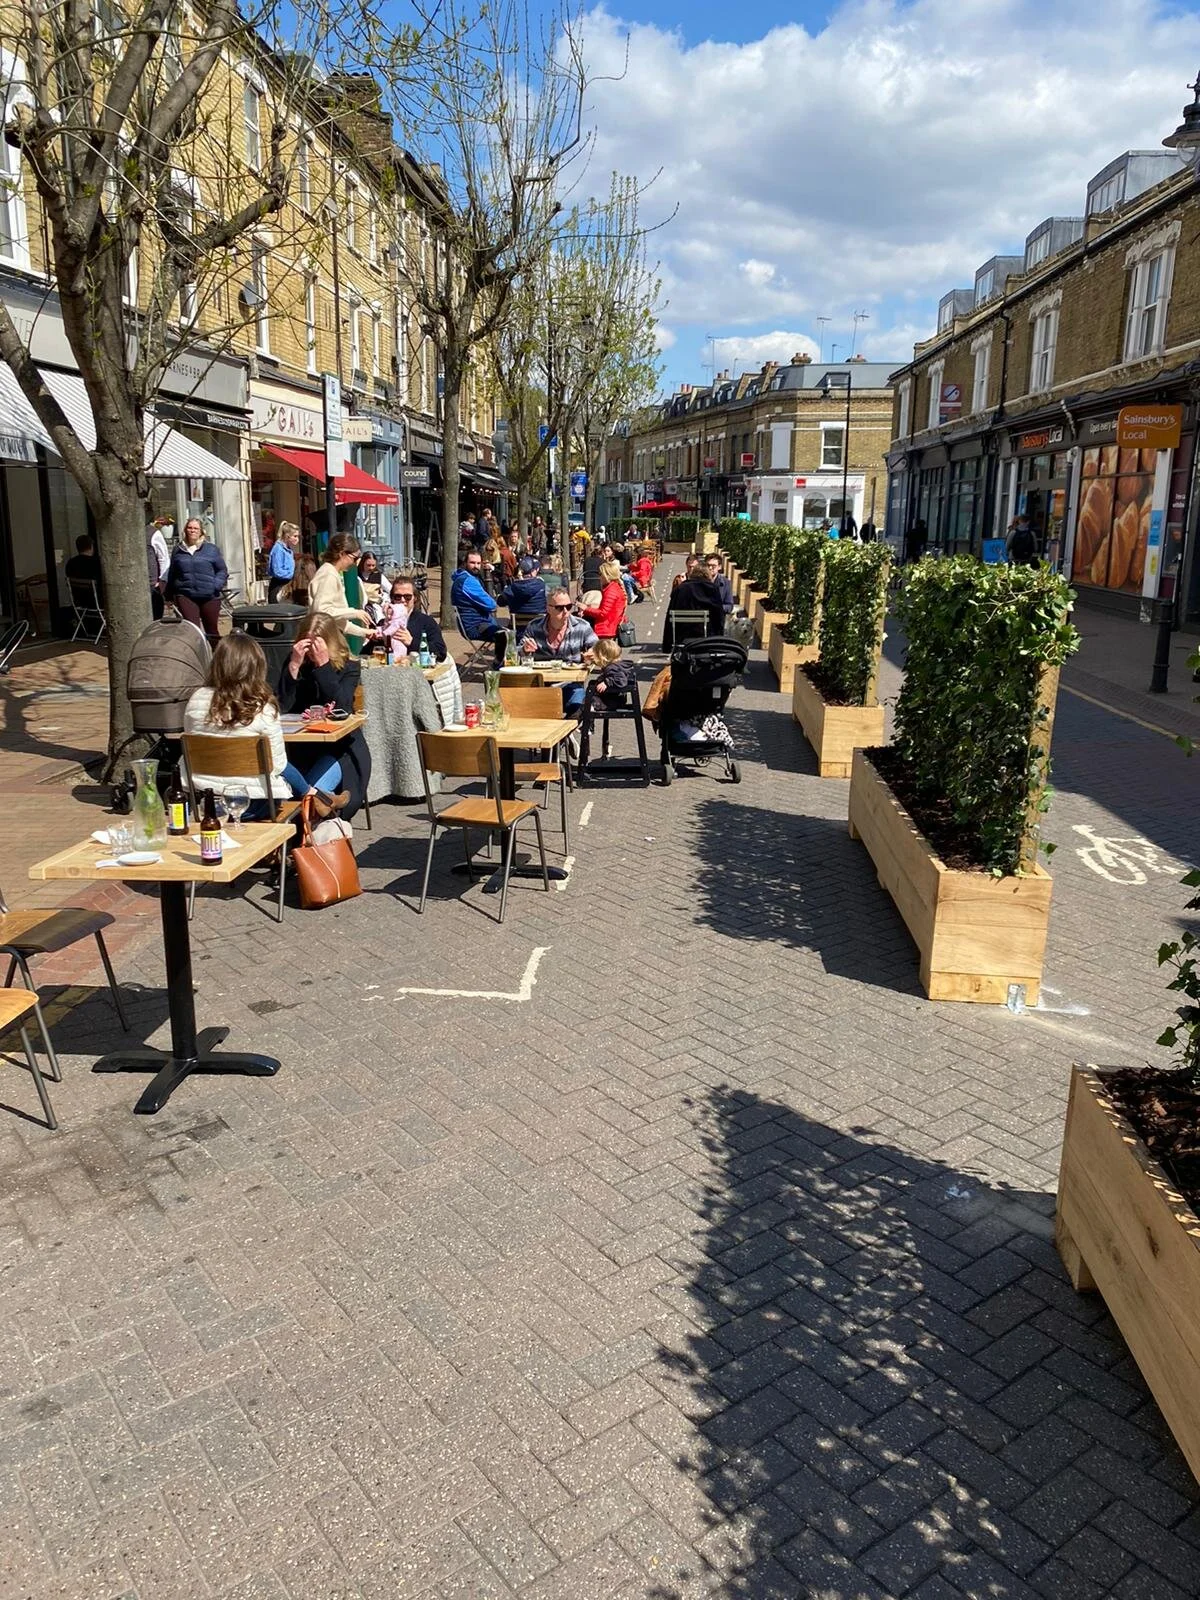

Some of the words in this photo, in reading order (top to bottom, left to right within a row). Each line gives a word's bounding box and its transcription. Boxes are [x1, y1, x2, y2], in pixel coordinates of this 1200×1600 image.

[278, 406, 314, 438] GAIL's
[1123, 414, 1176, 425] Sainsbury's
[342, 426, 368, 437] AIL's
[1122, 430, 1147, 440] Local
